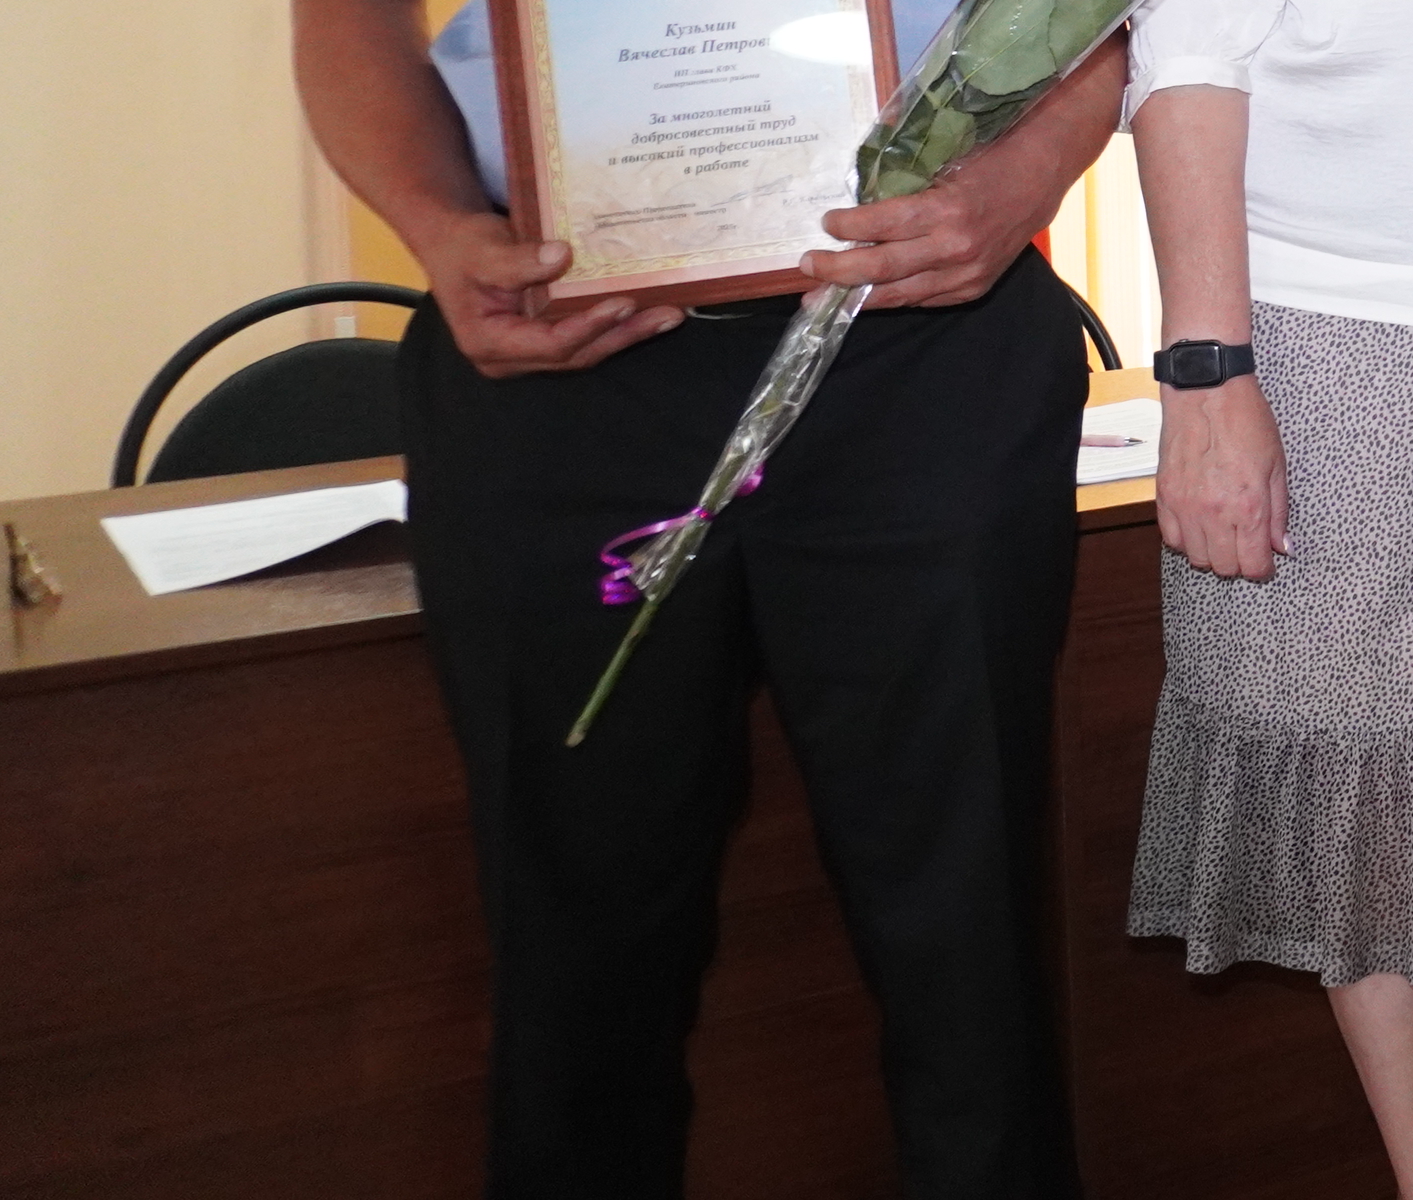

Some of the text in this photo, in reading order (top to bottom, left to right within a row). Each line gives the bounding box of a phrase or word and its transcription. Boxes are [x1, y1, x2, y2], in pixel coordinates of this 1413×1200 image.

[664, 20, 736, 40] Кузьмин
[618, 44, 696, 63] Вячеслав
[648, 100, 771, 125] За многолетний
[631, 115, 797, 145] добросовестный труд
[608, 132, 820, 166] и высокий профессионализм
[683, 158, 750, 176] в работе
